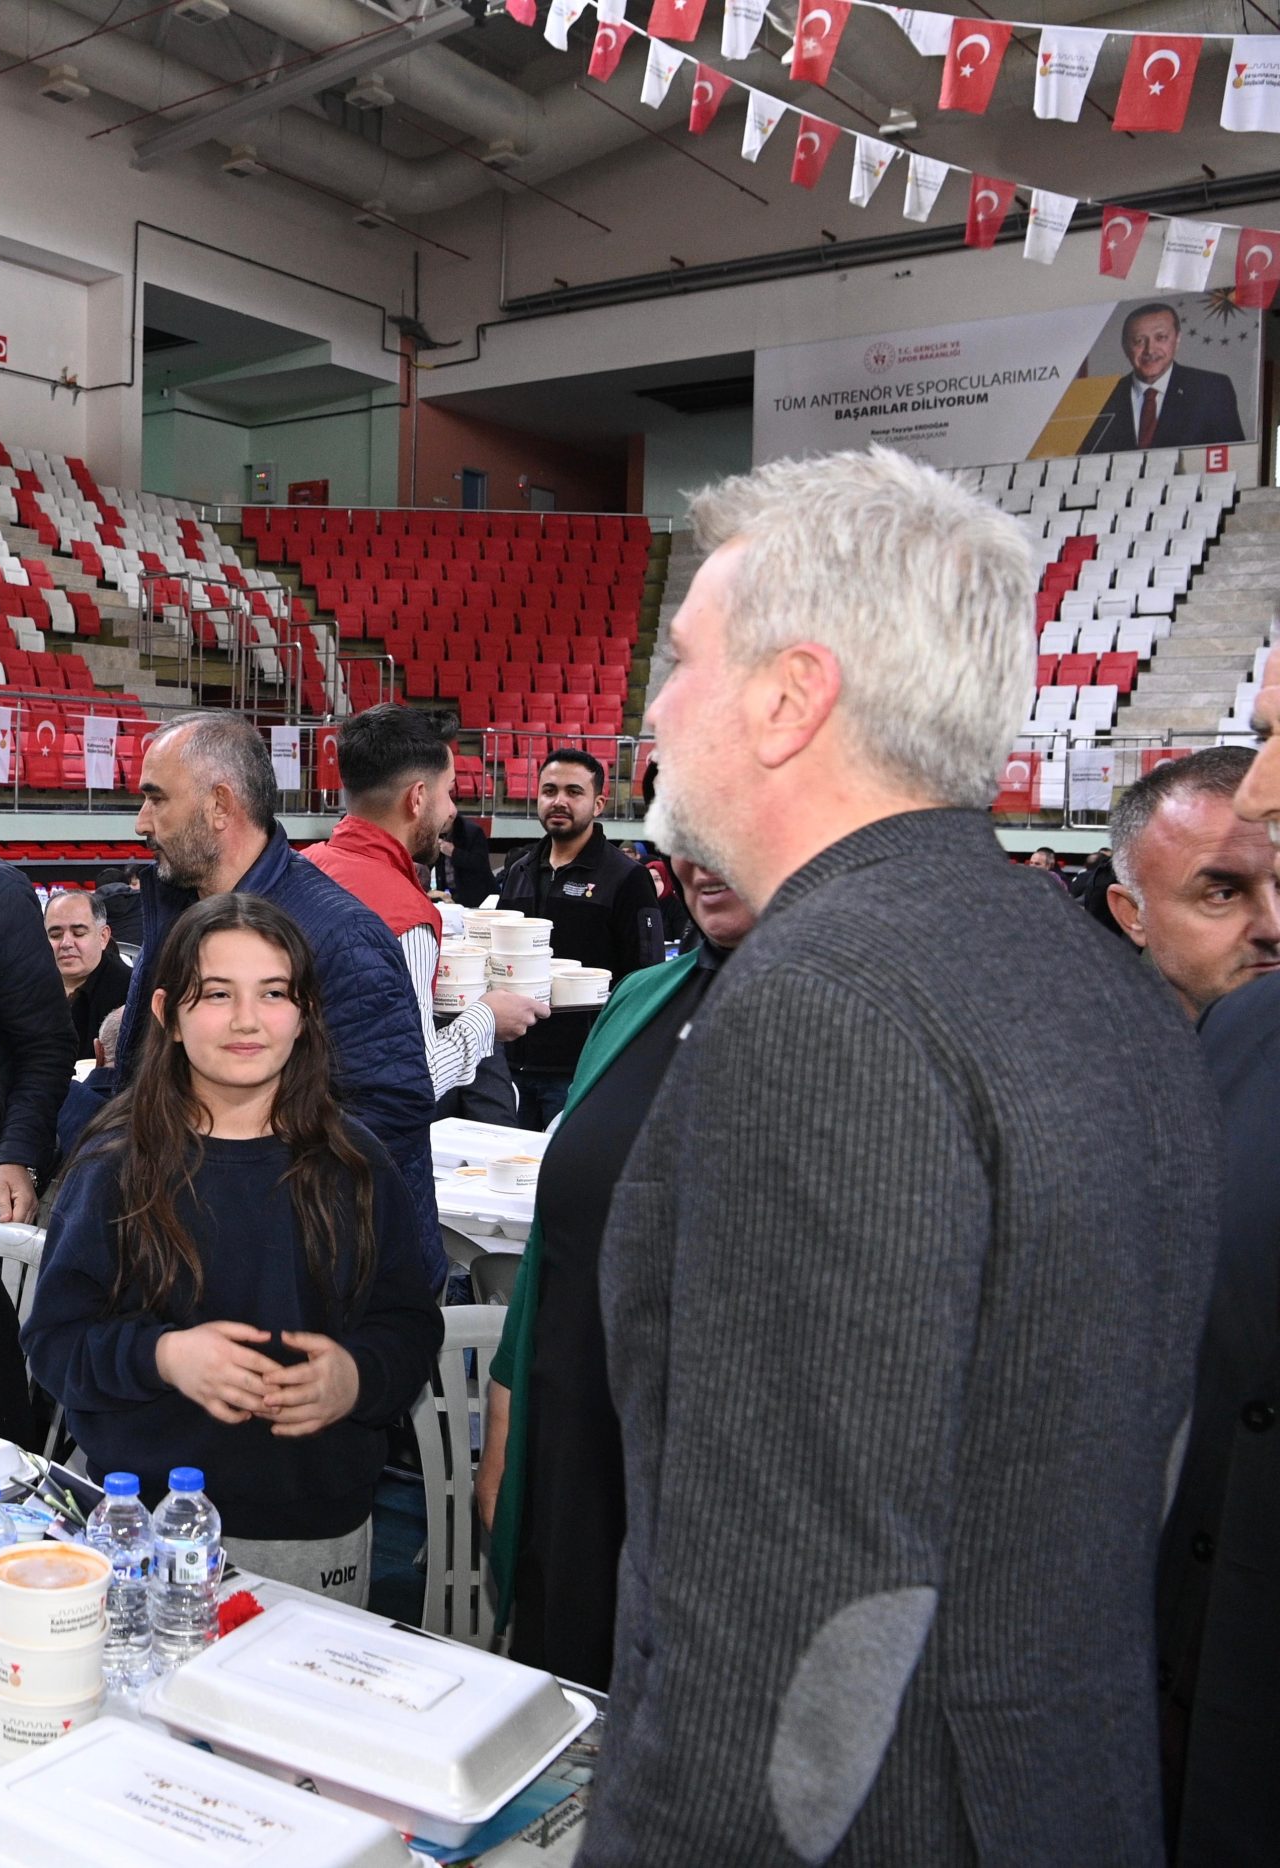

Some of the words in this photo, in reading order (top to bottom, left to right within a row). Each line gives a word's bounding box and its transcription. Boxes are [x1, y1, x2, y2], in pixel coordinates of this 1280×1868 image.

[773, 395, 807, 412] TÜM
[810, 383, 892, 409] ANTRENÖR
[895, 380, 915, 397] VE
[916, 365, 1060, 395] SPORCULARIMIZA
[834, 401, 908, 421] BAŞARILAR
[911, 392, 989, 411] DİLİYORUM
[1210, 449, 1223, 469] E
[320, 1564, 358, 1589] VOID
